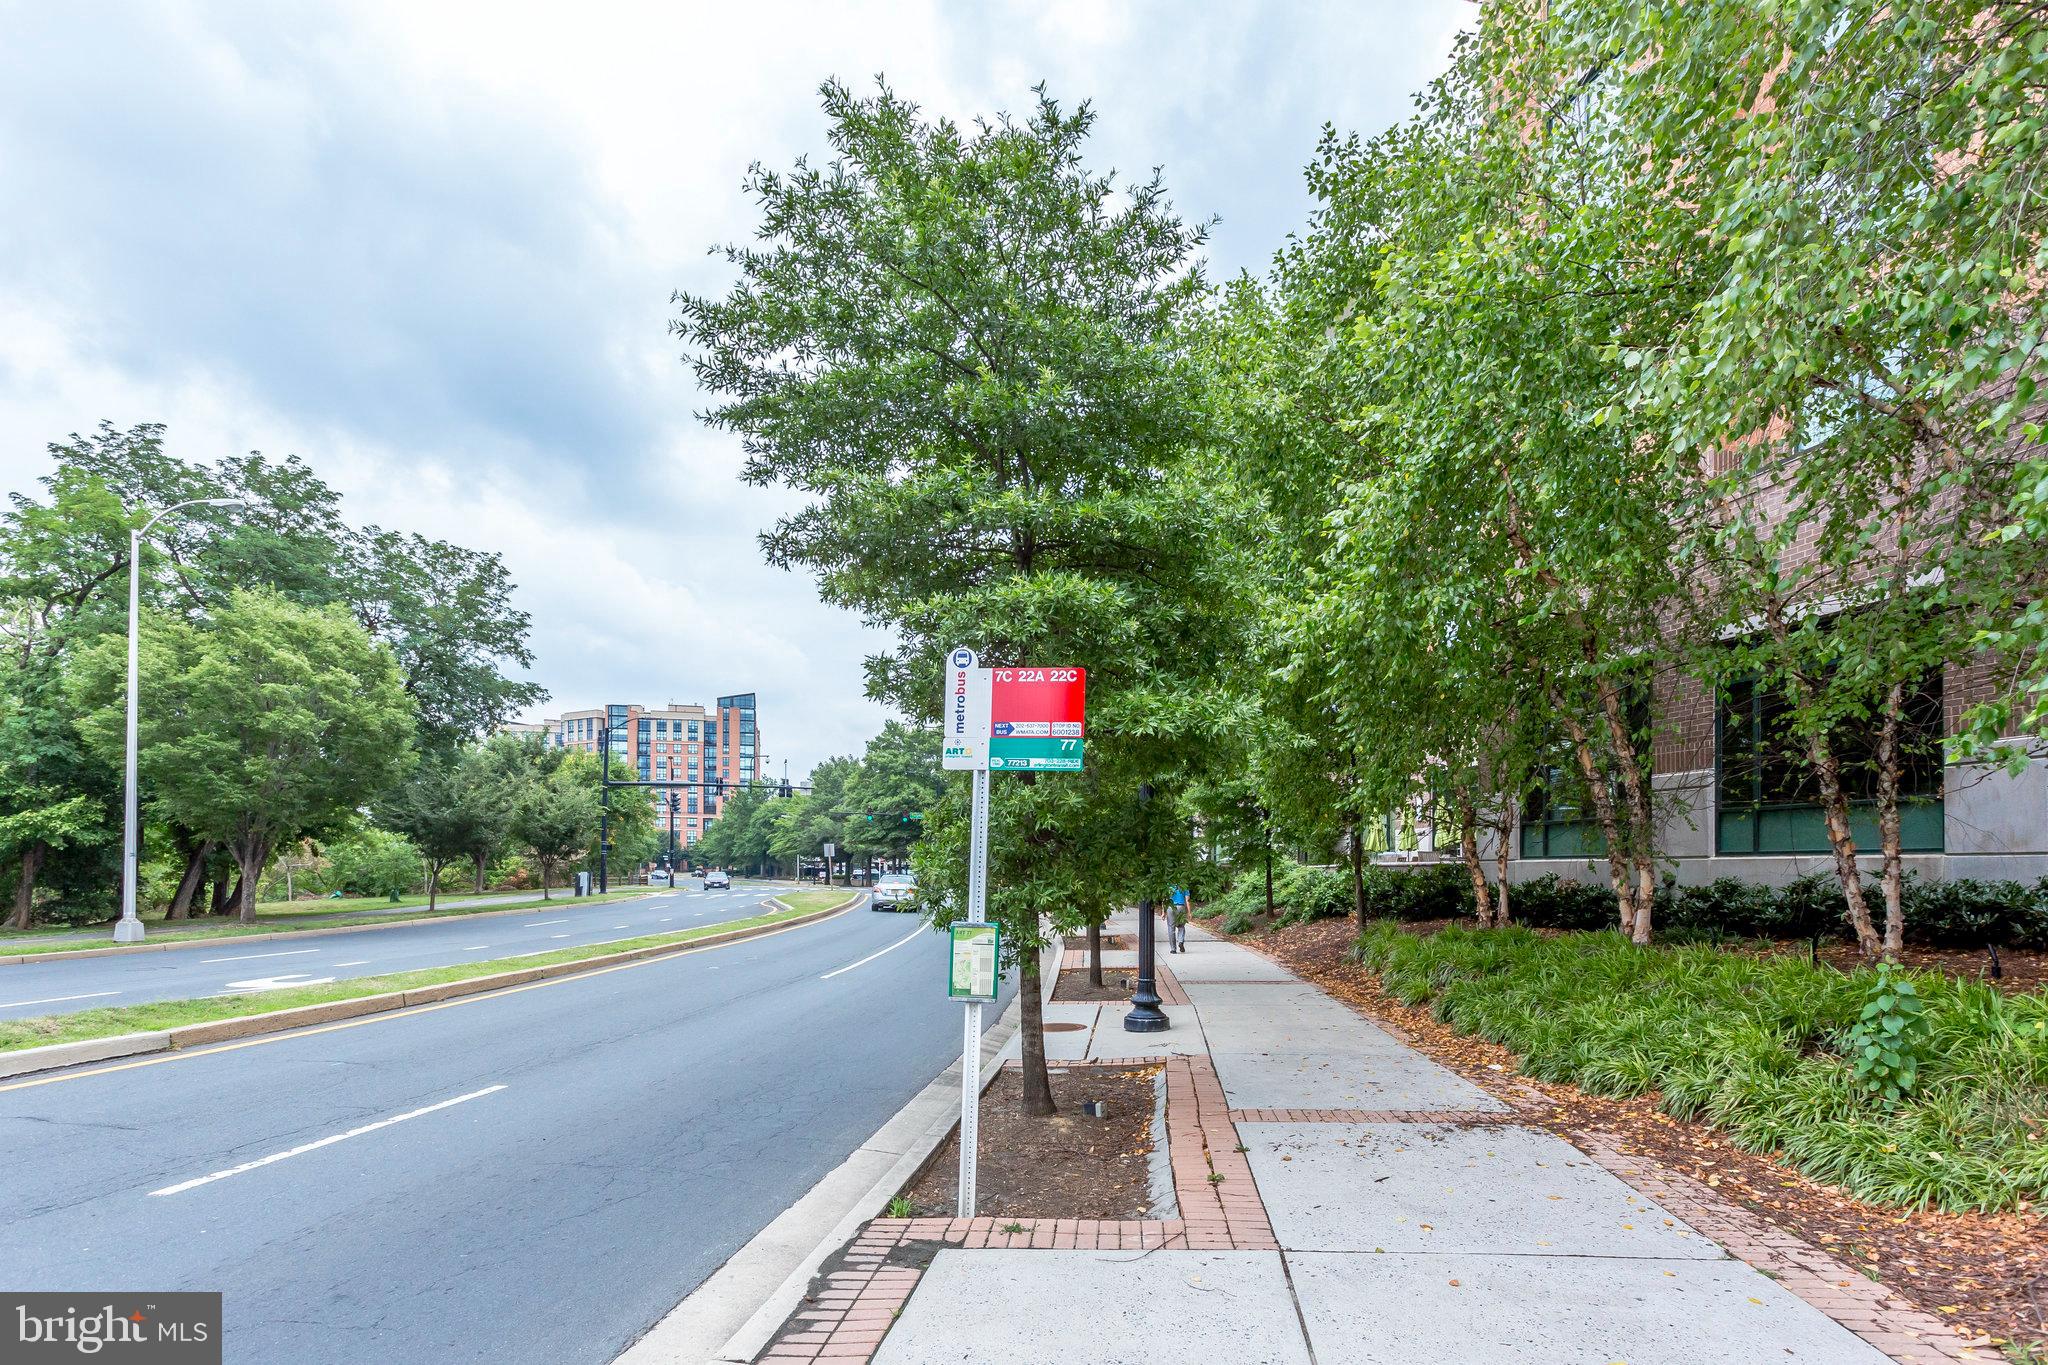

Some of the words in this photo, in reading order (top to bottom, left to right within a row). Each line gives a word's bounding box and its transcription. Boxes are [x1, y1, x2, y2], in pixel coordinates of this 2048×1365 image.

[995, 670, 1012, 682] 7C
[1018, 670, 1045, 682] 22A
[1050, 670, 1078, 682] 22C
[955, 671, 966, 734] metrobus
[1060, 739, 1077, 751] 77
[1007, 759, 1028, 767] 77213
